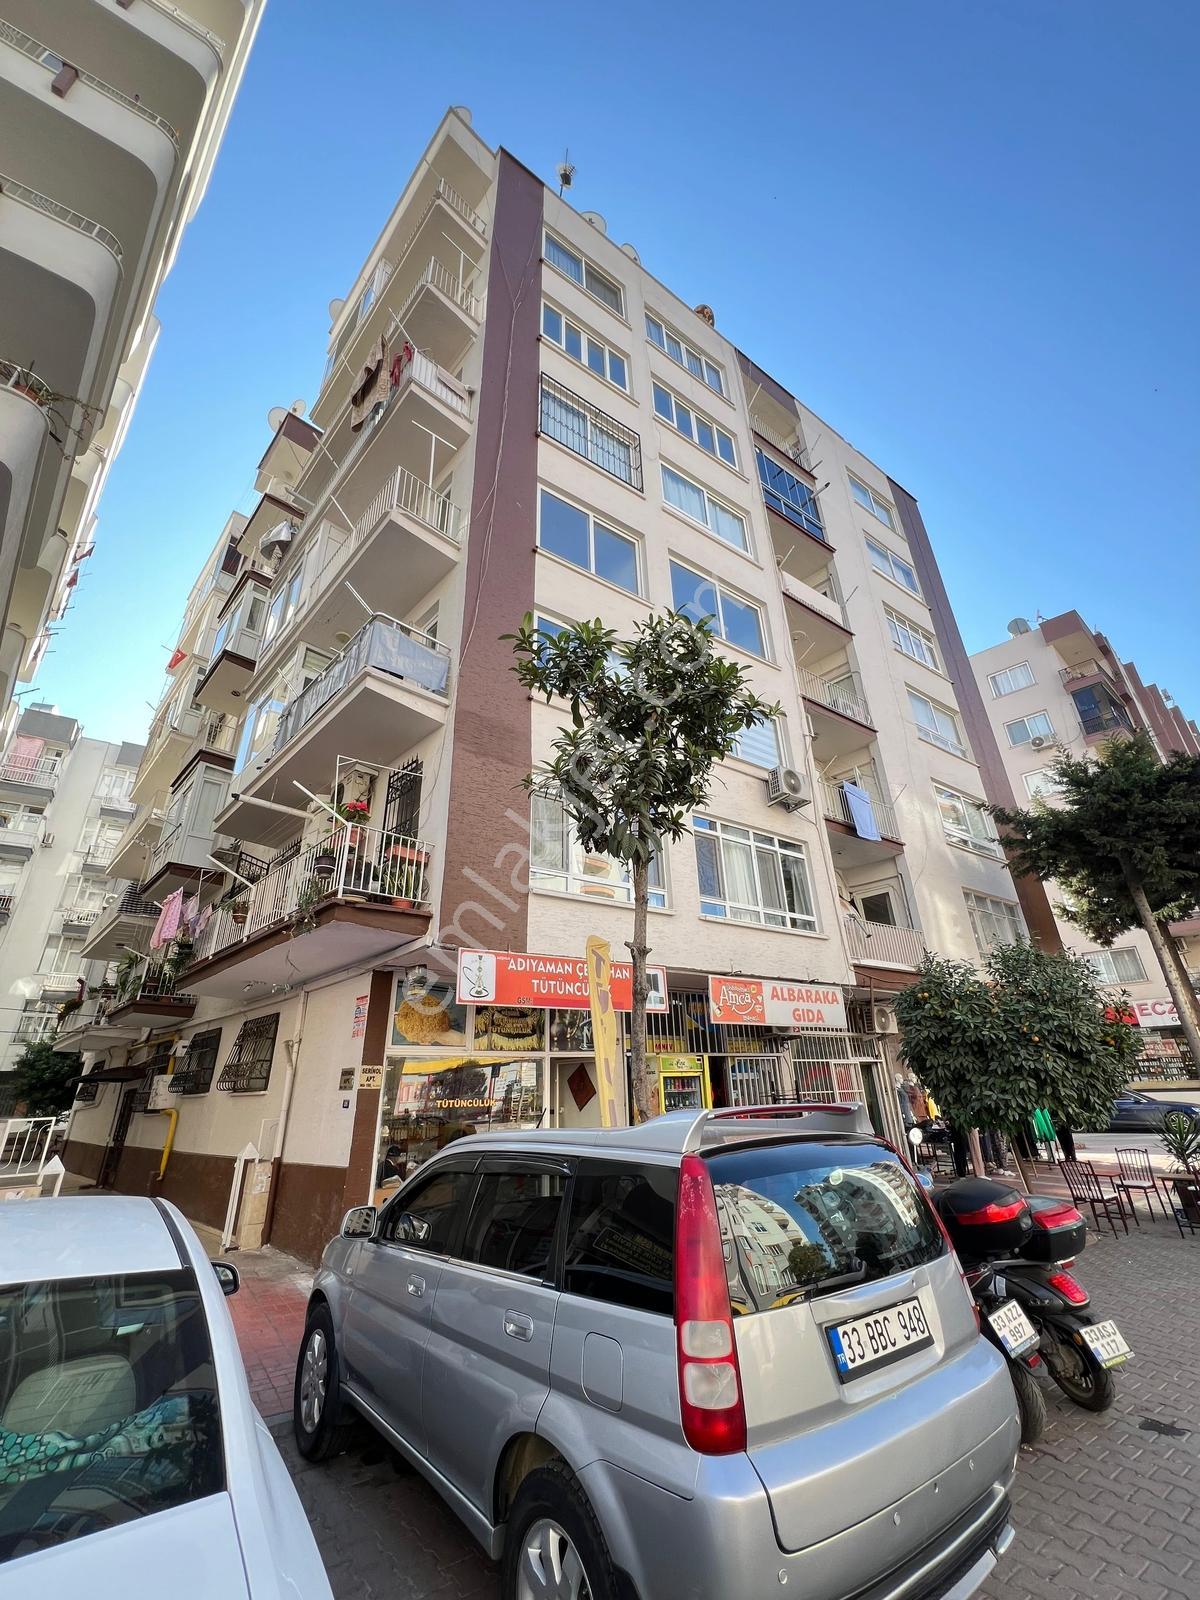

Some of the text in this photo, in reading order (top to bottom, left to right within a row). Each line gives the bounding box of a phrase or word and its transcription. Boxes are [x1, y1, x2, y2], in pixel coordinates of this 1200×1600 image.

[508, 957, 630, 980] ADIYAMAN ÇEHAN
[719, 986, 752, 1006] Amca
[771, 986, 839, 1005] ALBARAKA
[792, 1007, 825, 1024] GIDA
[993, 1305, 1022, 1331] 33 AZZ
[842, 1305, 925, 1363] 33 BBC 948
[1009, 1323, 1027, 1342] 997
[1085, 1322, 1117, 1343] 33 ASJ
[1101, 1339, 1120, 1356] 117
[837, 1353, 847, 1364] TR
